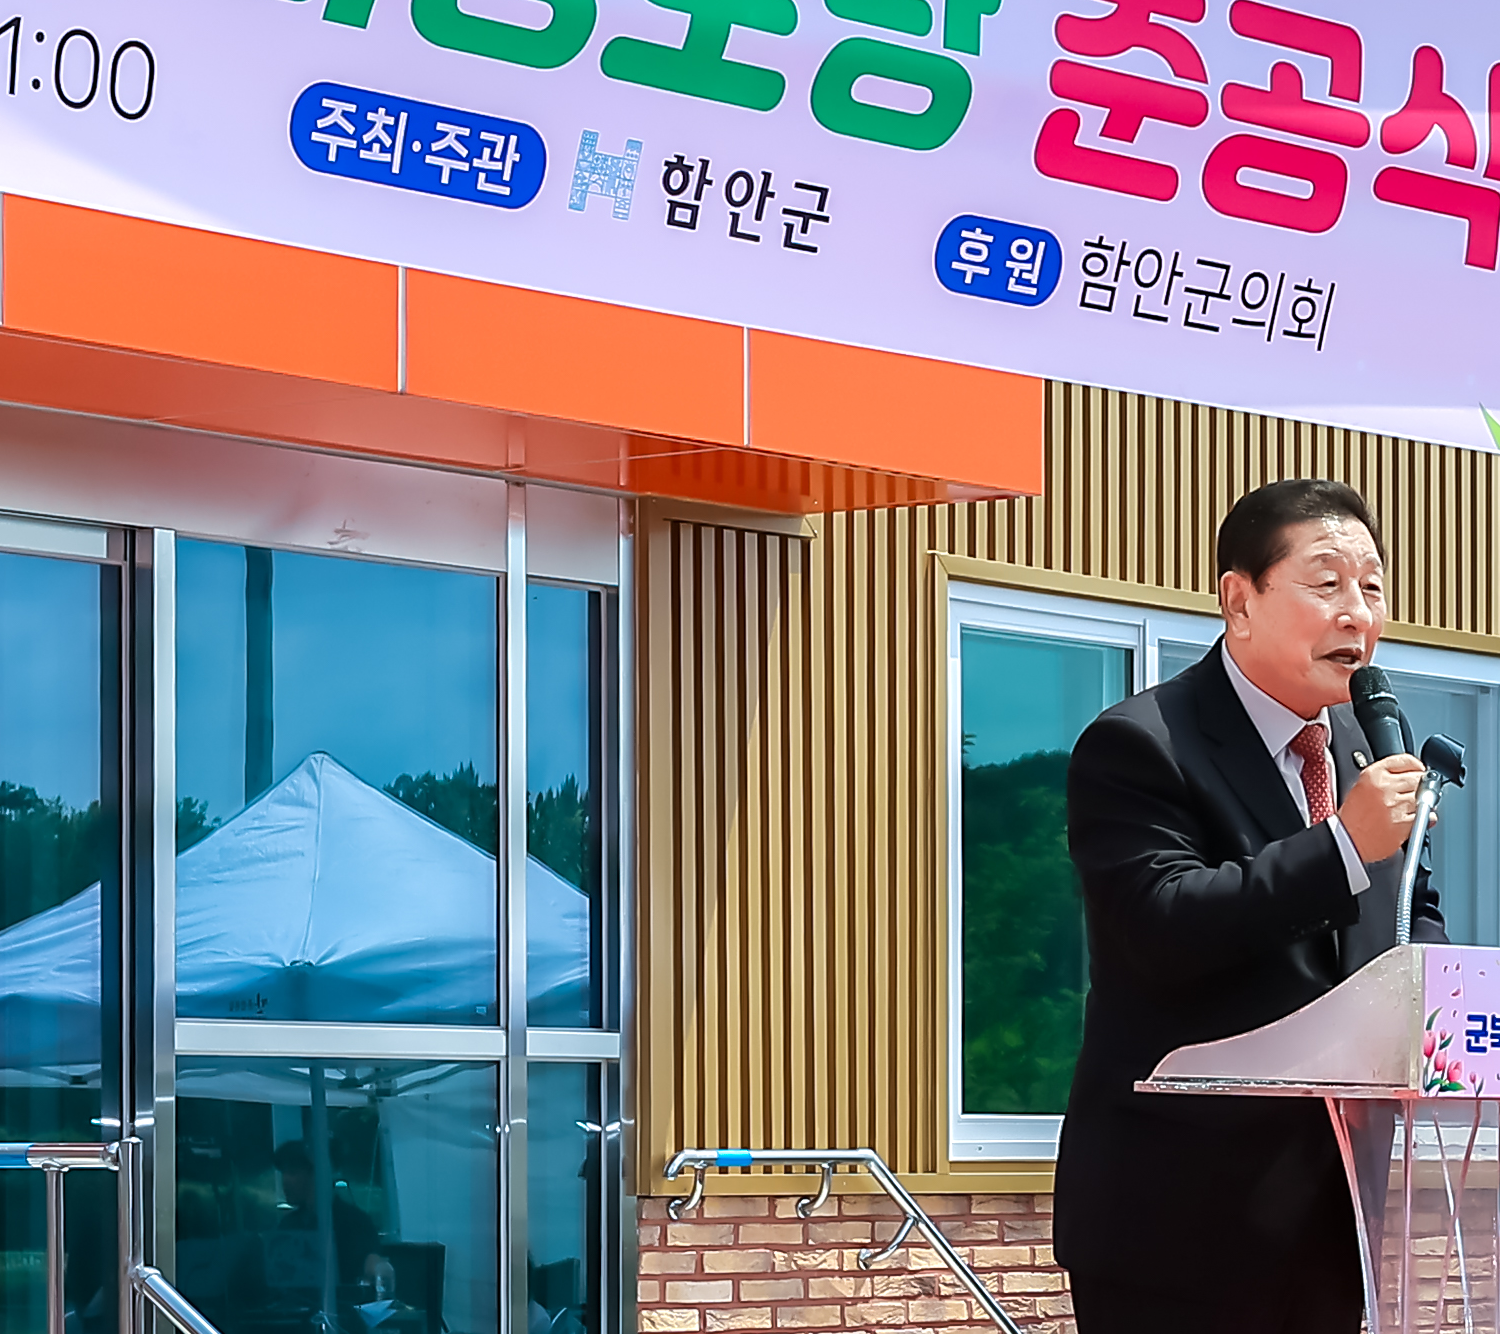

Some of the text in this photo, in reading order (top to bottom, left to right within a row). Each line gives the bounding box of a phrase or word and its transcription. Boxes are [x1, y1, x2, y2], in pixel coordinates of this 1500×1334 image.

[310, 96, 521, 197] 주최·주관
[661, 153, 831, 254] 함안군
[1078, 234, 1337, 353] 함안군의회
